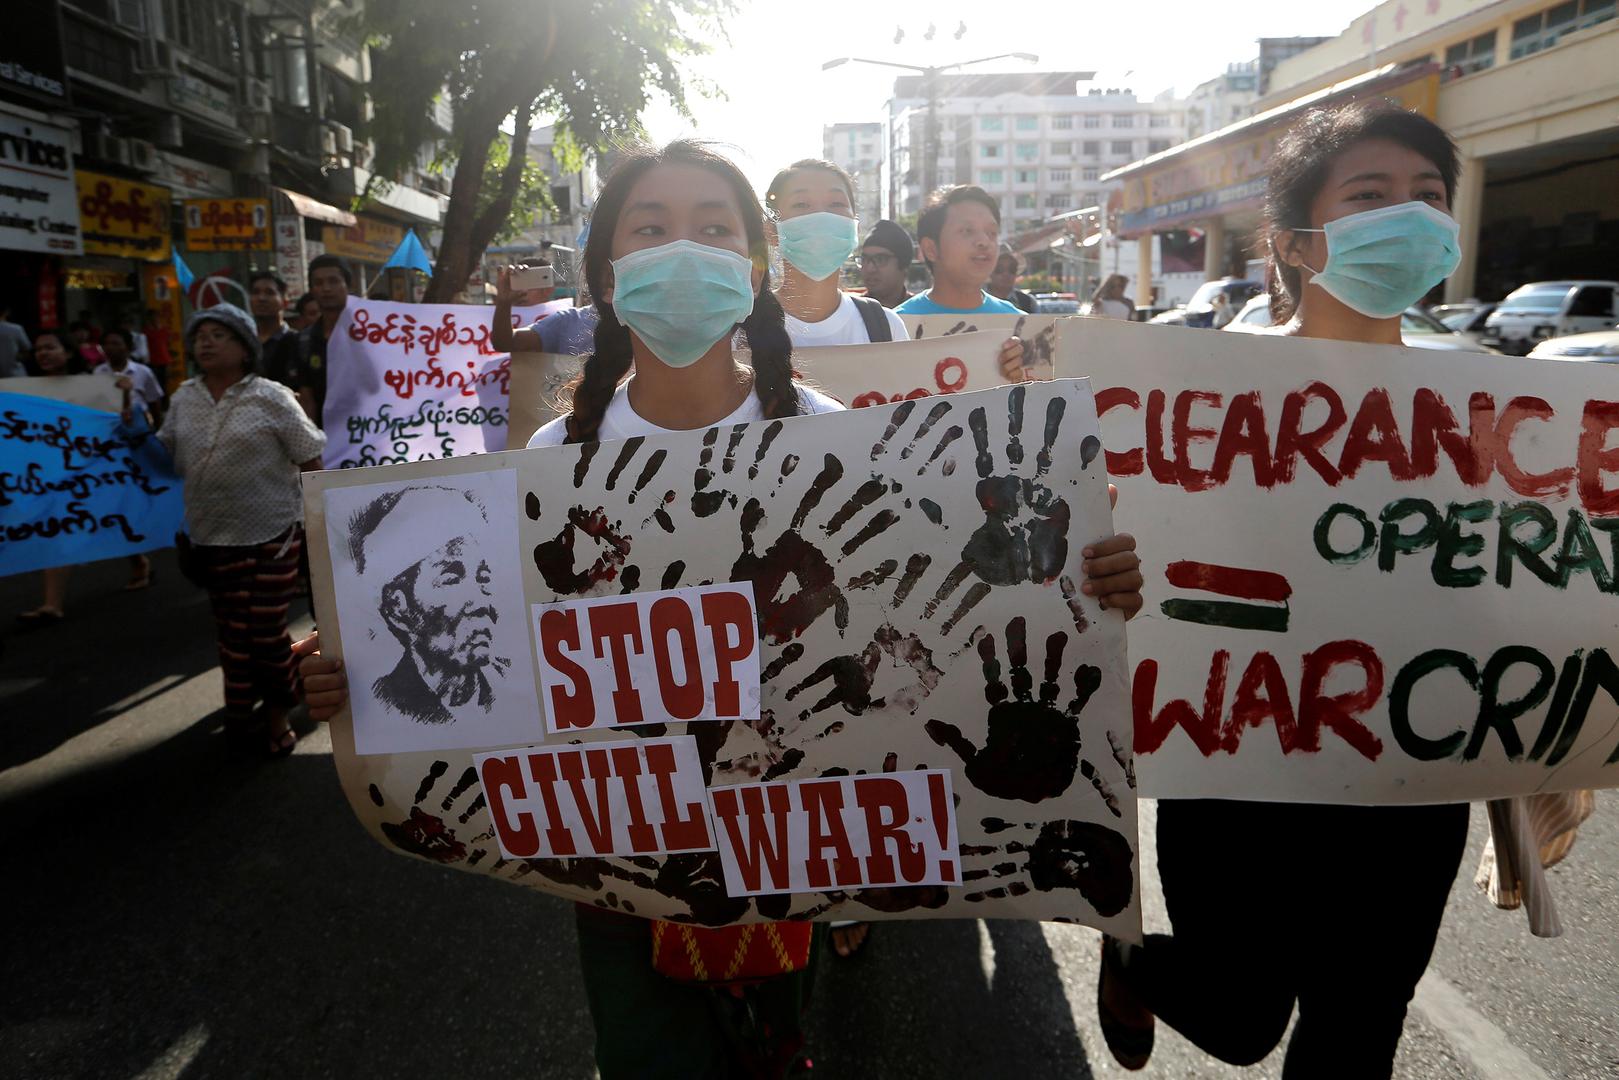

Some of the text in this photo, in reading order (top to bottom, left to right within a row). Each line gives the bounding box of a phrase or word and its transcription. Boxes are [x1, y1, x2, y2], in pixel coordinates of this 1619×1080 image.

[1100, 381, 1619, 518] CLEARANCE
[539, 591, 755, 730] STOP
[1133, 640, 1383, 762] WAR
[481, 743, 711, 857] CIVIL
[711, 773, 956, 892] WAR!
